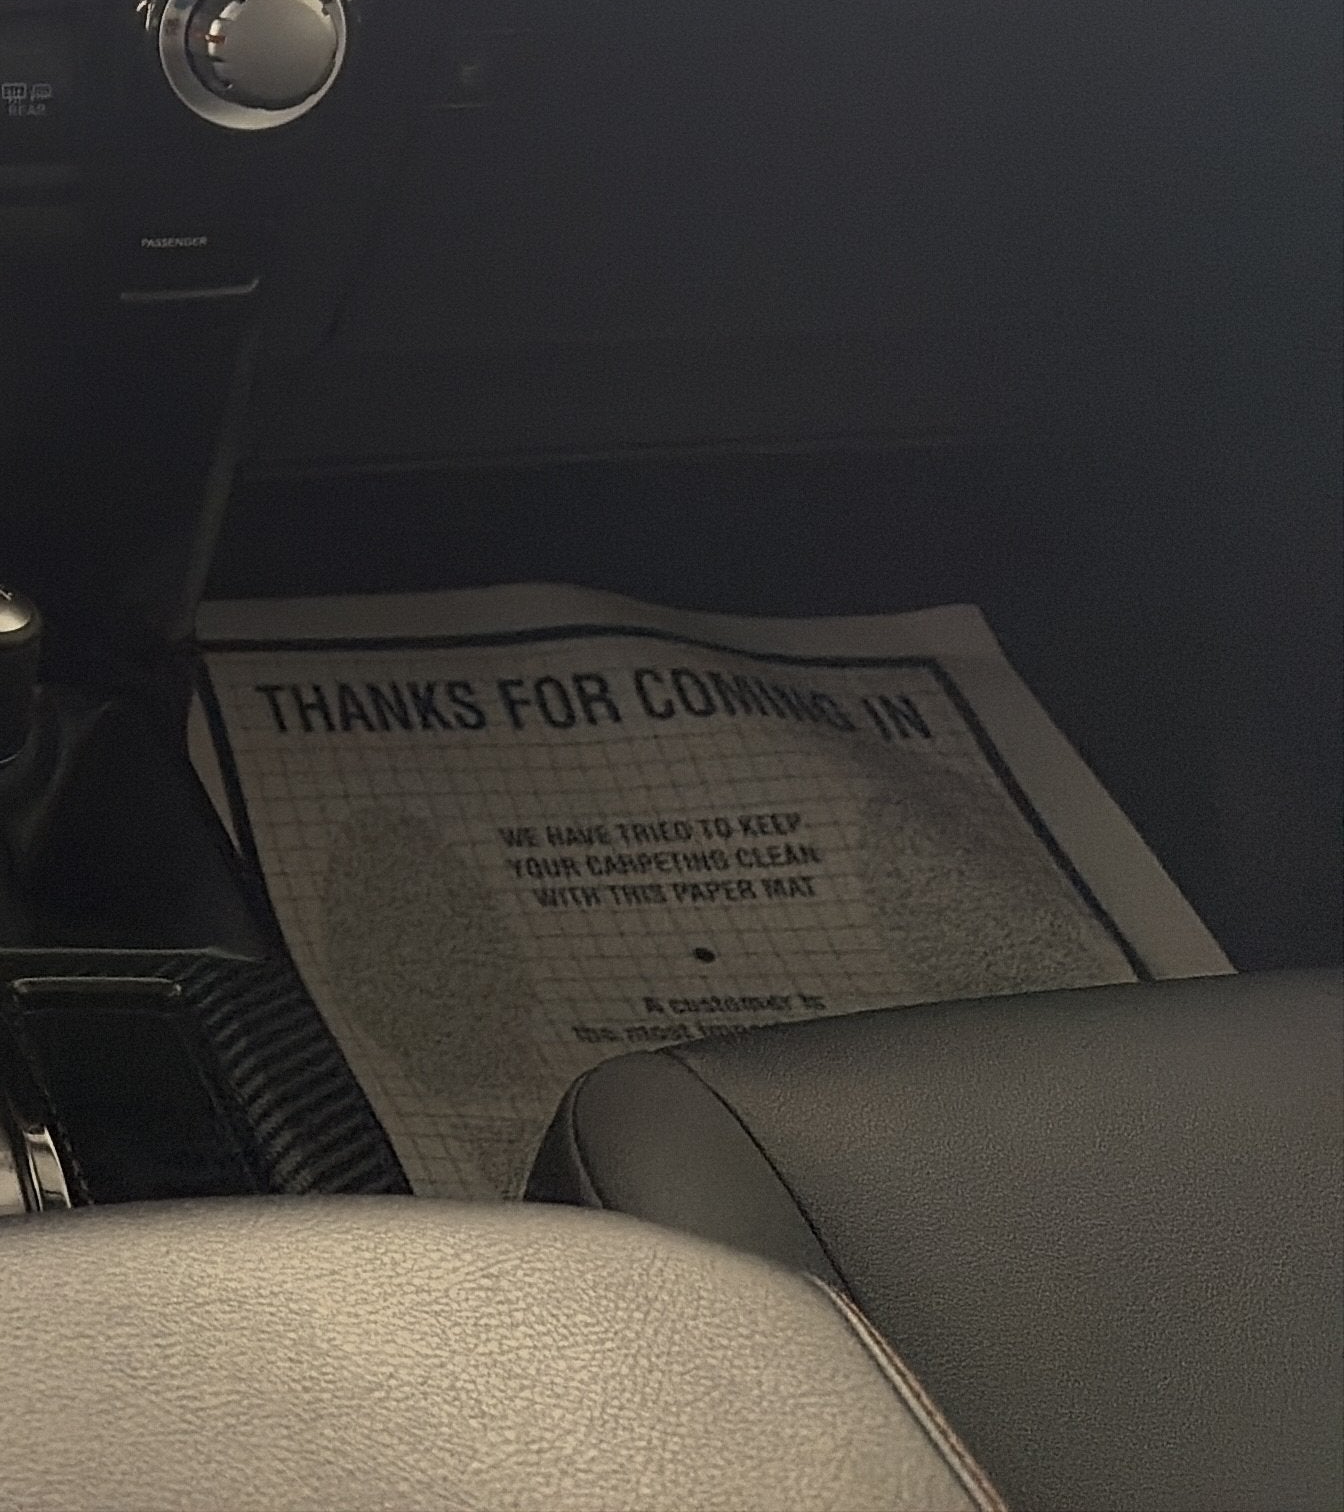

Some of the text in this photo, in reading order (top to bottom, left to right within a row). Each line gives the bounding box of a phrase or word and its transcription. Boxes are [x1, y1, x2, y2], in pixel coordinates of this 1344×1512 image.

[256, 666, 932, 741] THANKS FOR COMING IN
[499, 812, 801, 848] WE HAVE TRIED TO KEEP
[506, 842, 824, 880] YOUR CARPETING CLEAN
[533, 875, 816, 908] WITH THIS PAPER MAT
